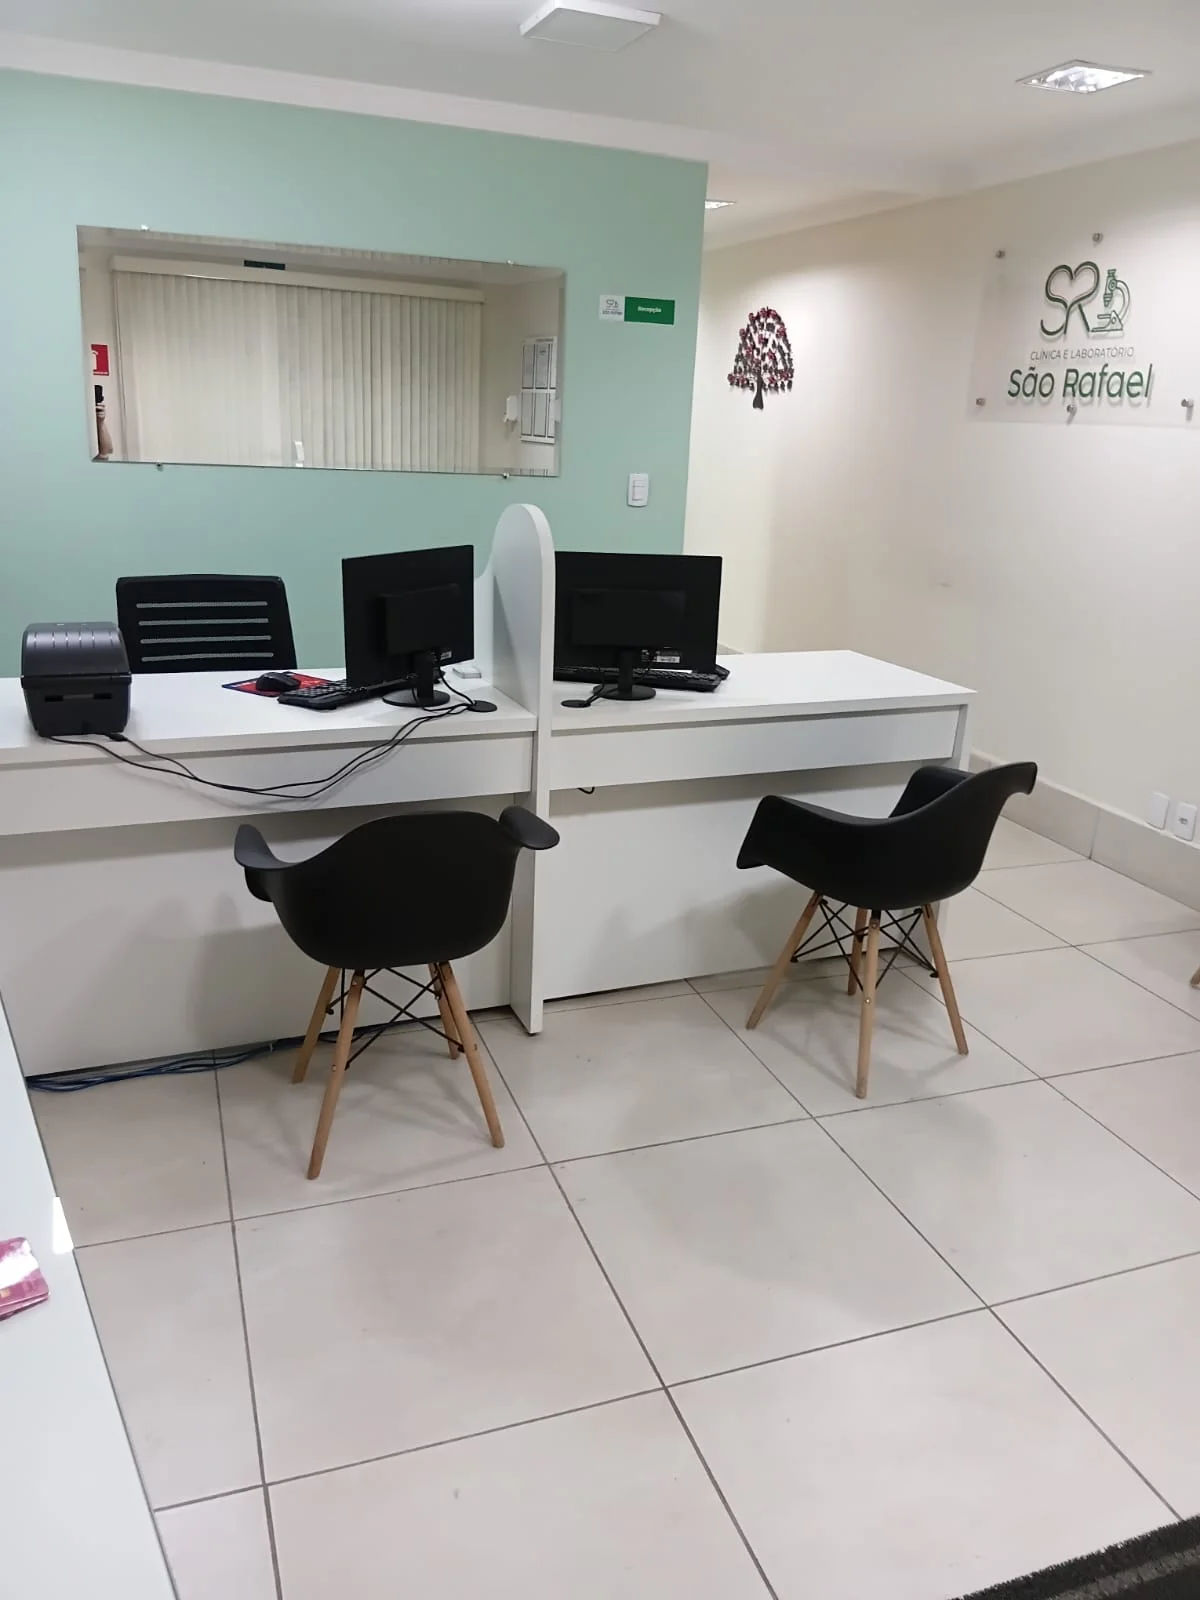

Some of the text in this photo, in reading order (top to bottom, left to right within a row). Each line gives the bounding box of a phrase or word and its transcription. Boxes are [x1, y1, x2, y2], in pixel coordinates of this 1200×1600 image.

[1030, 346, 1134, 361] CLÍNICA E LABORATÓRIO
[1008, 363, 1153, 398] São Rafael
